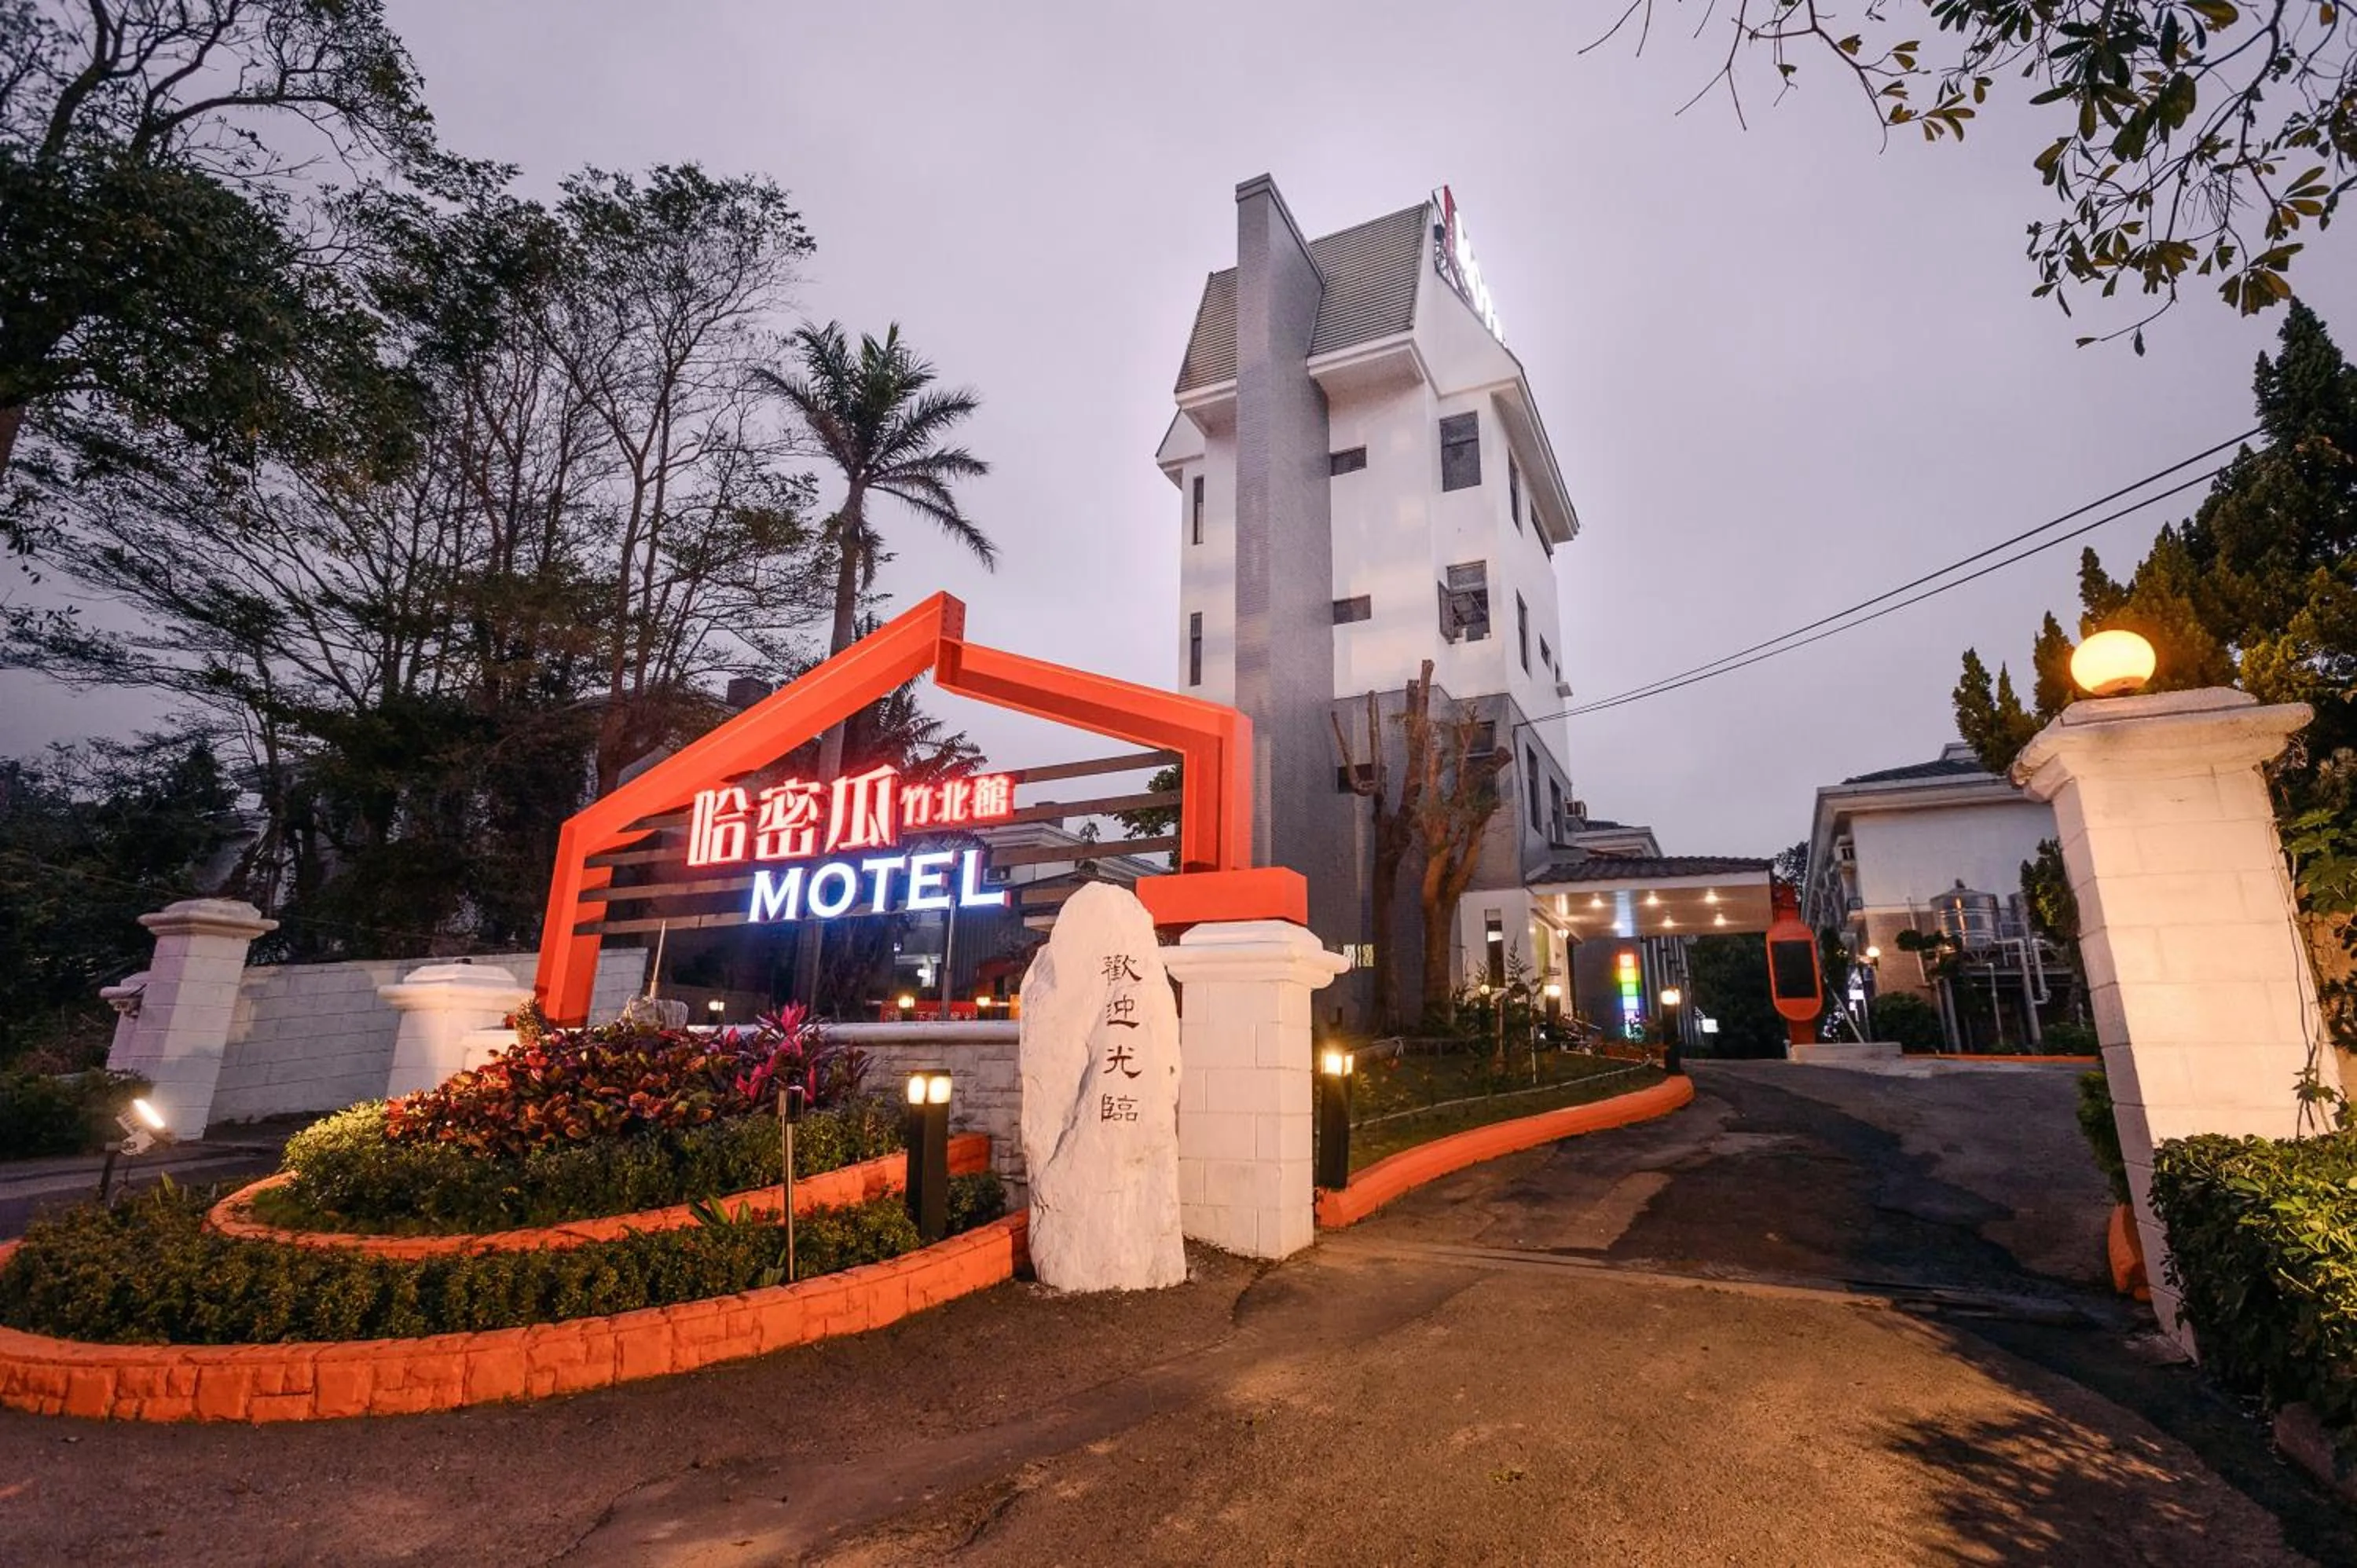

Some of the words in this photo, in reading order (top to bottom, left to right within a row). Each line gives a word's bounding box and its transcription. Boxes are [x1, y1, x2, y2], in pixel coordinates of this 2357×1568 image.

[687, 764, 900, 866] 哈密瓜
[900, 775, 1010, 826] 竹北館
[748, 850, 1005, 922] MOTEL
[1101, 954, 1142, 1123] 歡迎光臨
